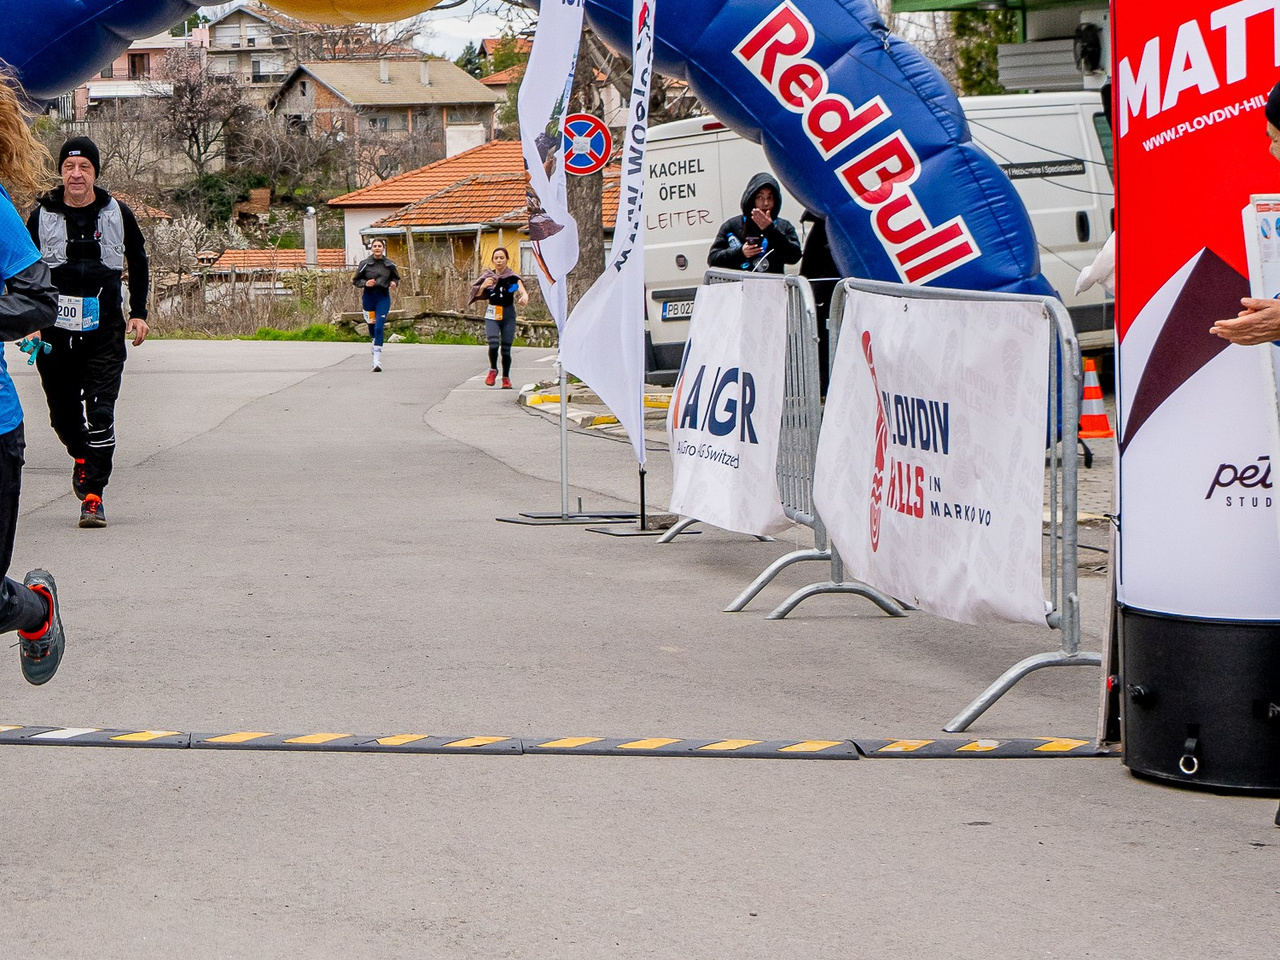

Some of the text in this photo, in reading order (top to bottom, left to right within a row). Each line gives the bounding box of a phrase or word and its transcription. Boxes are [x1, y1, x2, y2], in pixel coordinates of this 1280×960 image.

[734, 0, 979, 286] Red Bull
[649, 158, 705, 179] KACHEL
[659, 182, 696, 201] ÖFEN
[646, 209, 713, 231] LEITER
[929, 475, 941, 493] IN
[930, 500, 991, 526] MARKOVO
